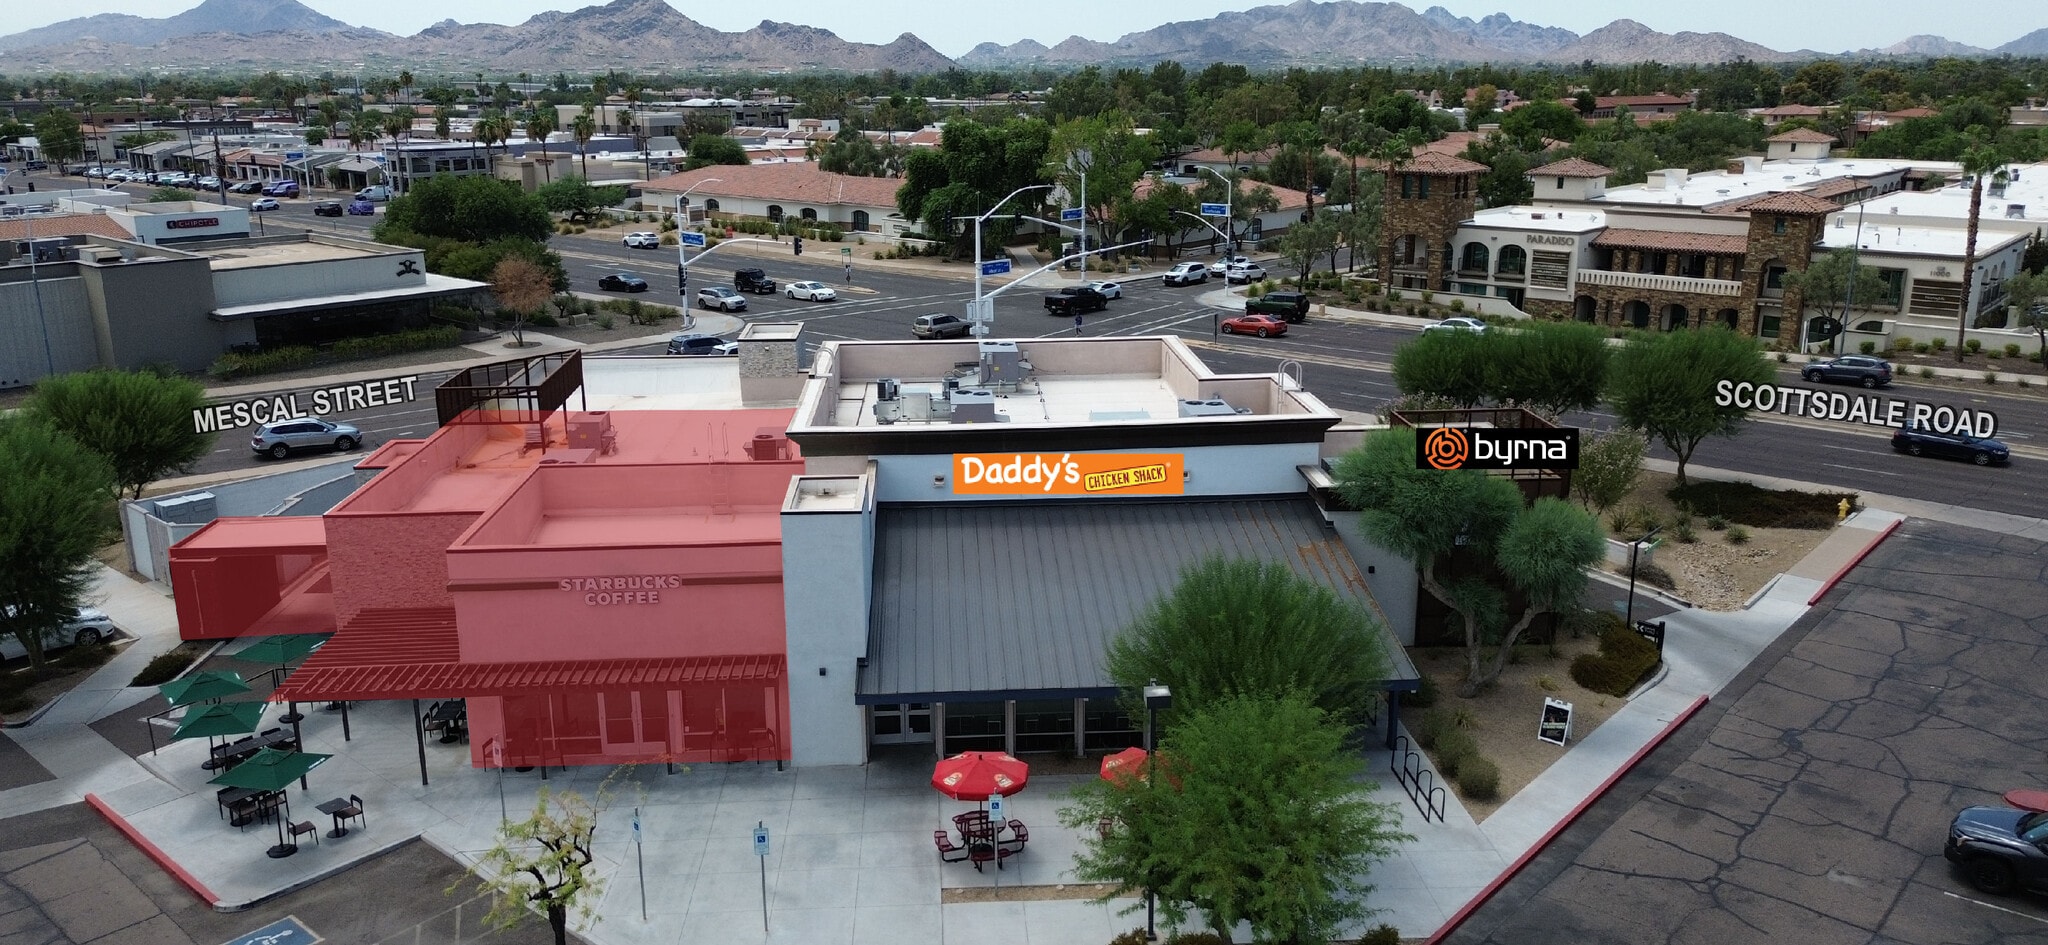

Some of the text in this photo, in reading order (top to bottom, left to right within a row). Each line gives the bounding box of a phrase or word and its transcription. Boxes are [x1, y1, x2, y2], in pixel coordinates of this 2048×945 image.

[179, 219, 217, 228] CHIPOTLE
[1526, 234, 1574, 246] PARADISO
[560, 575, 680, 592] STARBUCKS
[584, 591, 659, 606] COFFEE
